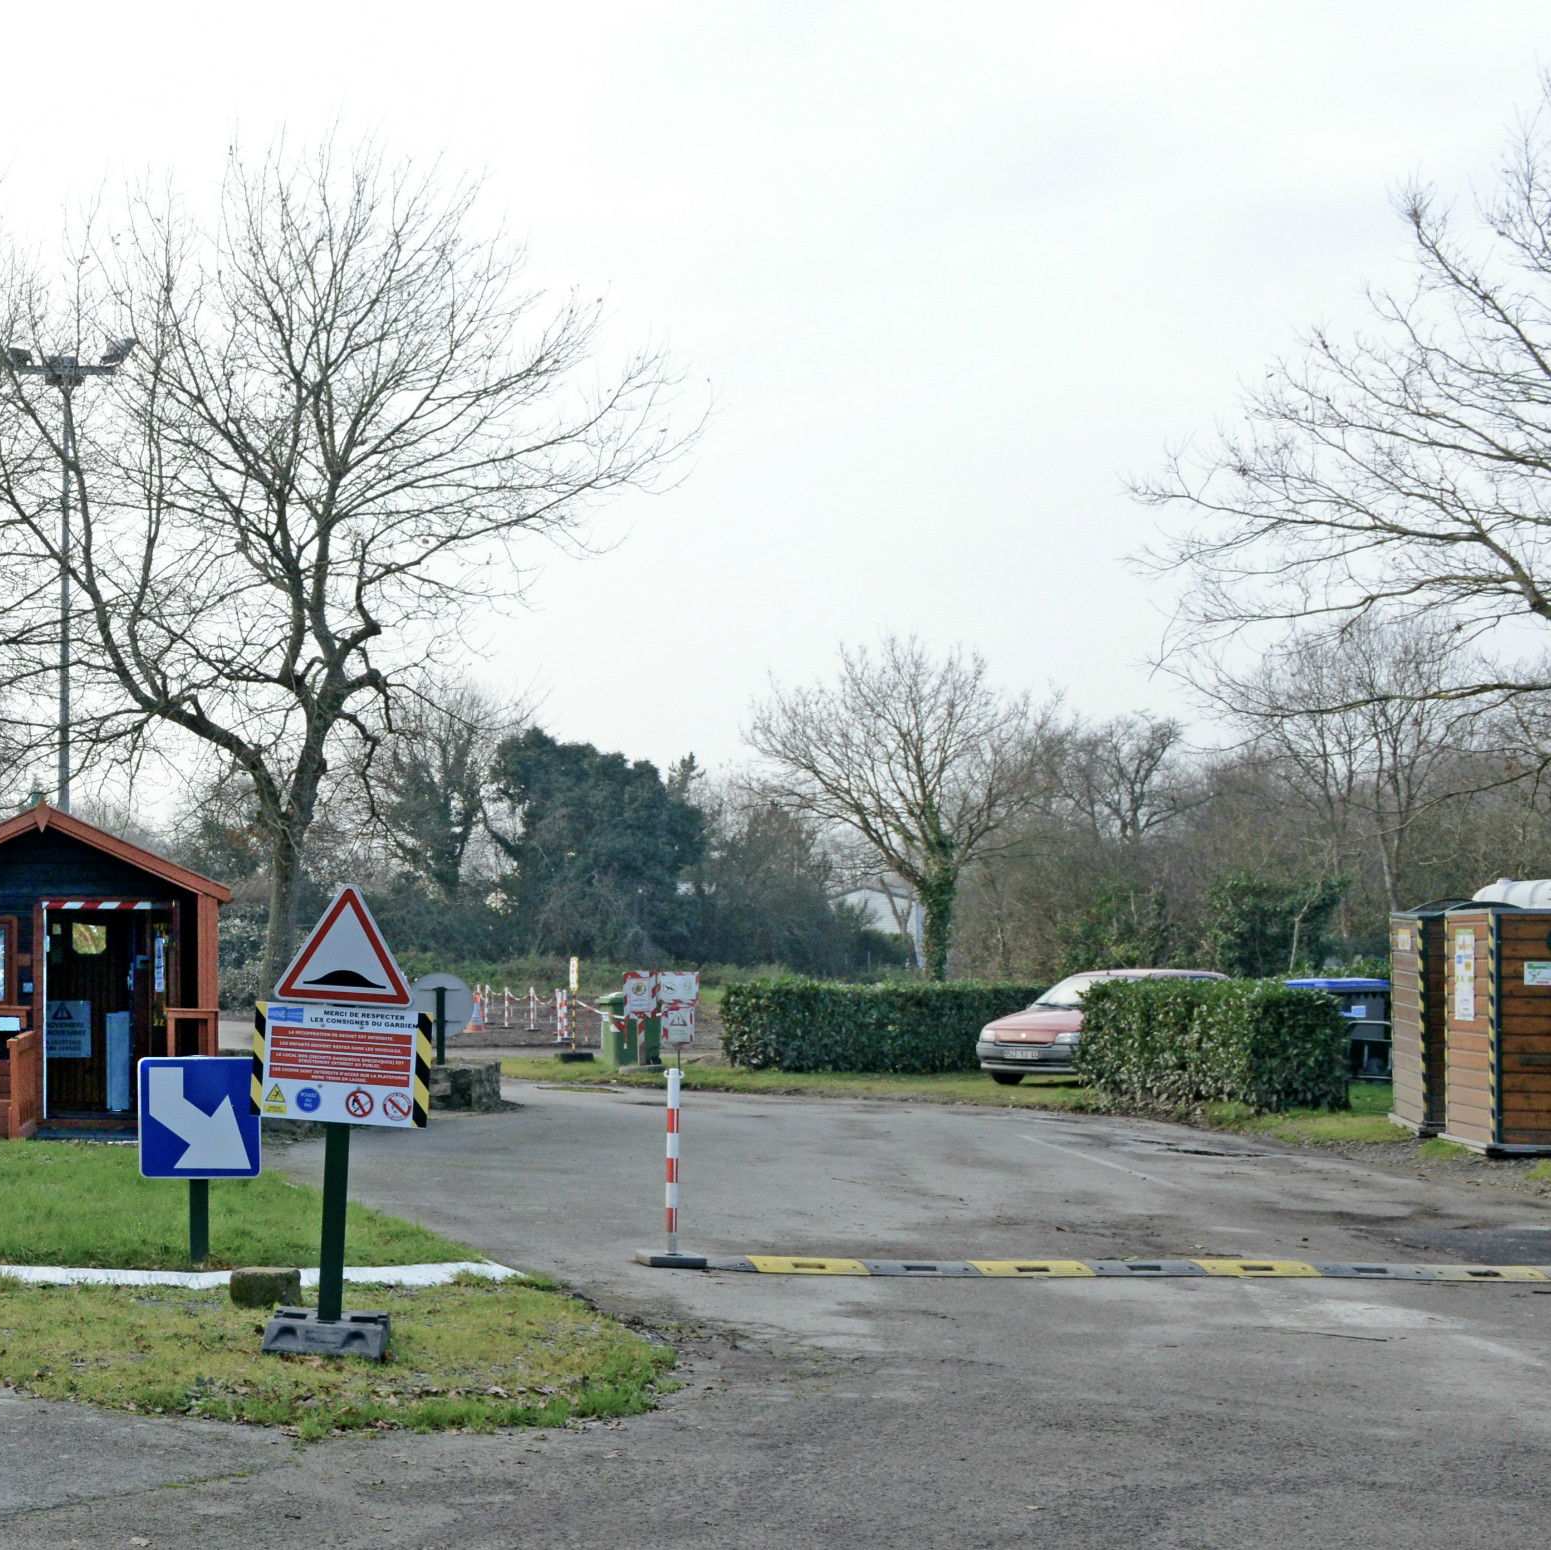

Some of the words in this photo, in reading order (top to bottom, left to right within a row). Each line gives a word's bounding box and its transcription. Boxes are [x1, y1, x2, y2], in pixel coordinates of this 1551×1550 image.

[361, 1012, 405, 1021] RESPECTER
[326, 1017, 369, 1026] CONSIGNES
[385, 1021, 418, 1029] GARDIEN
